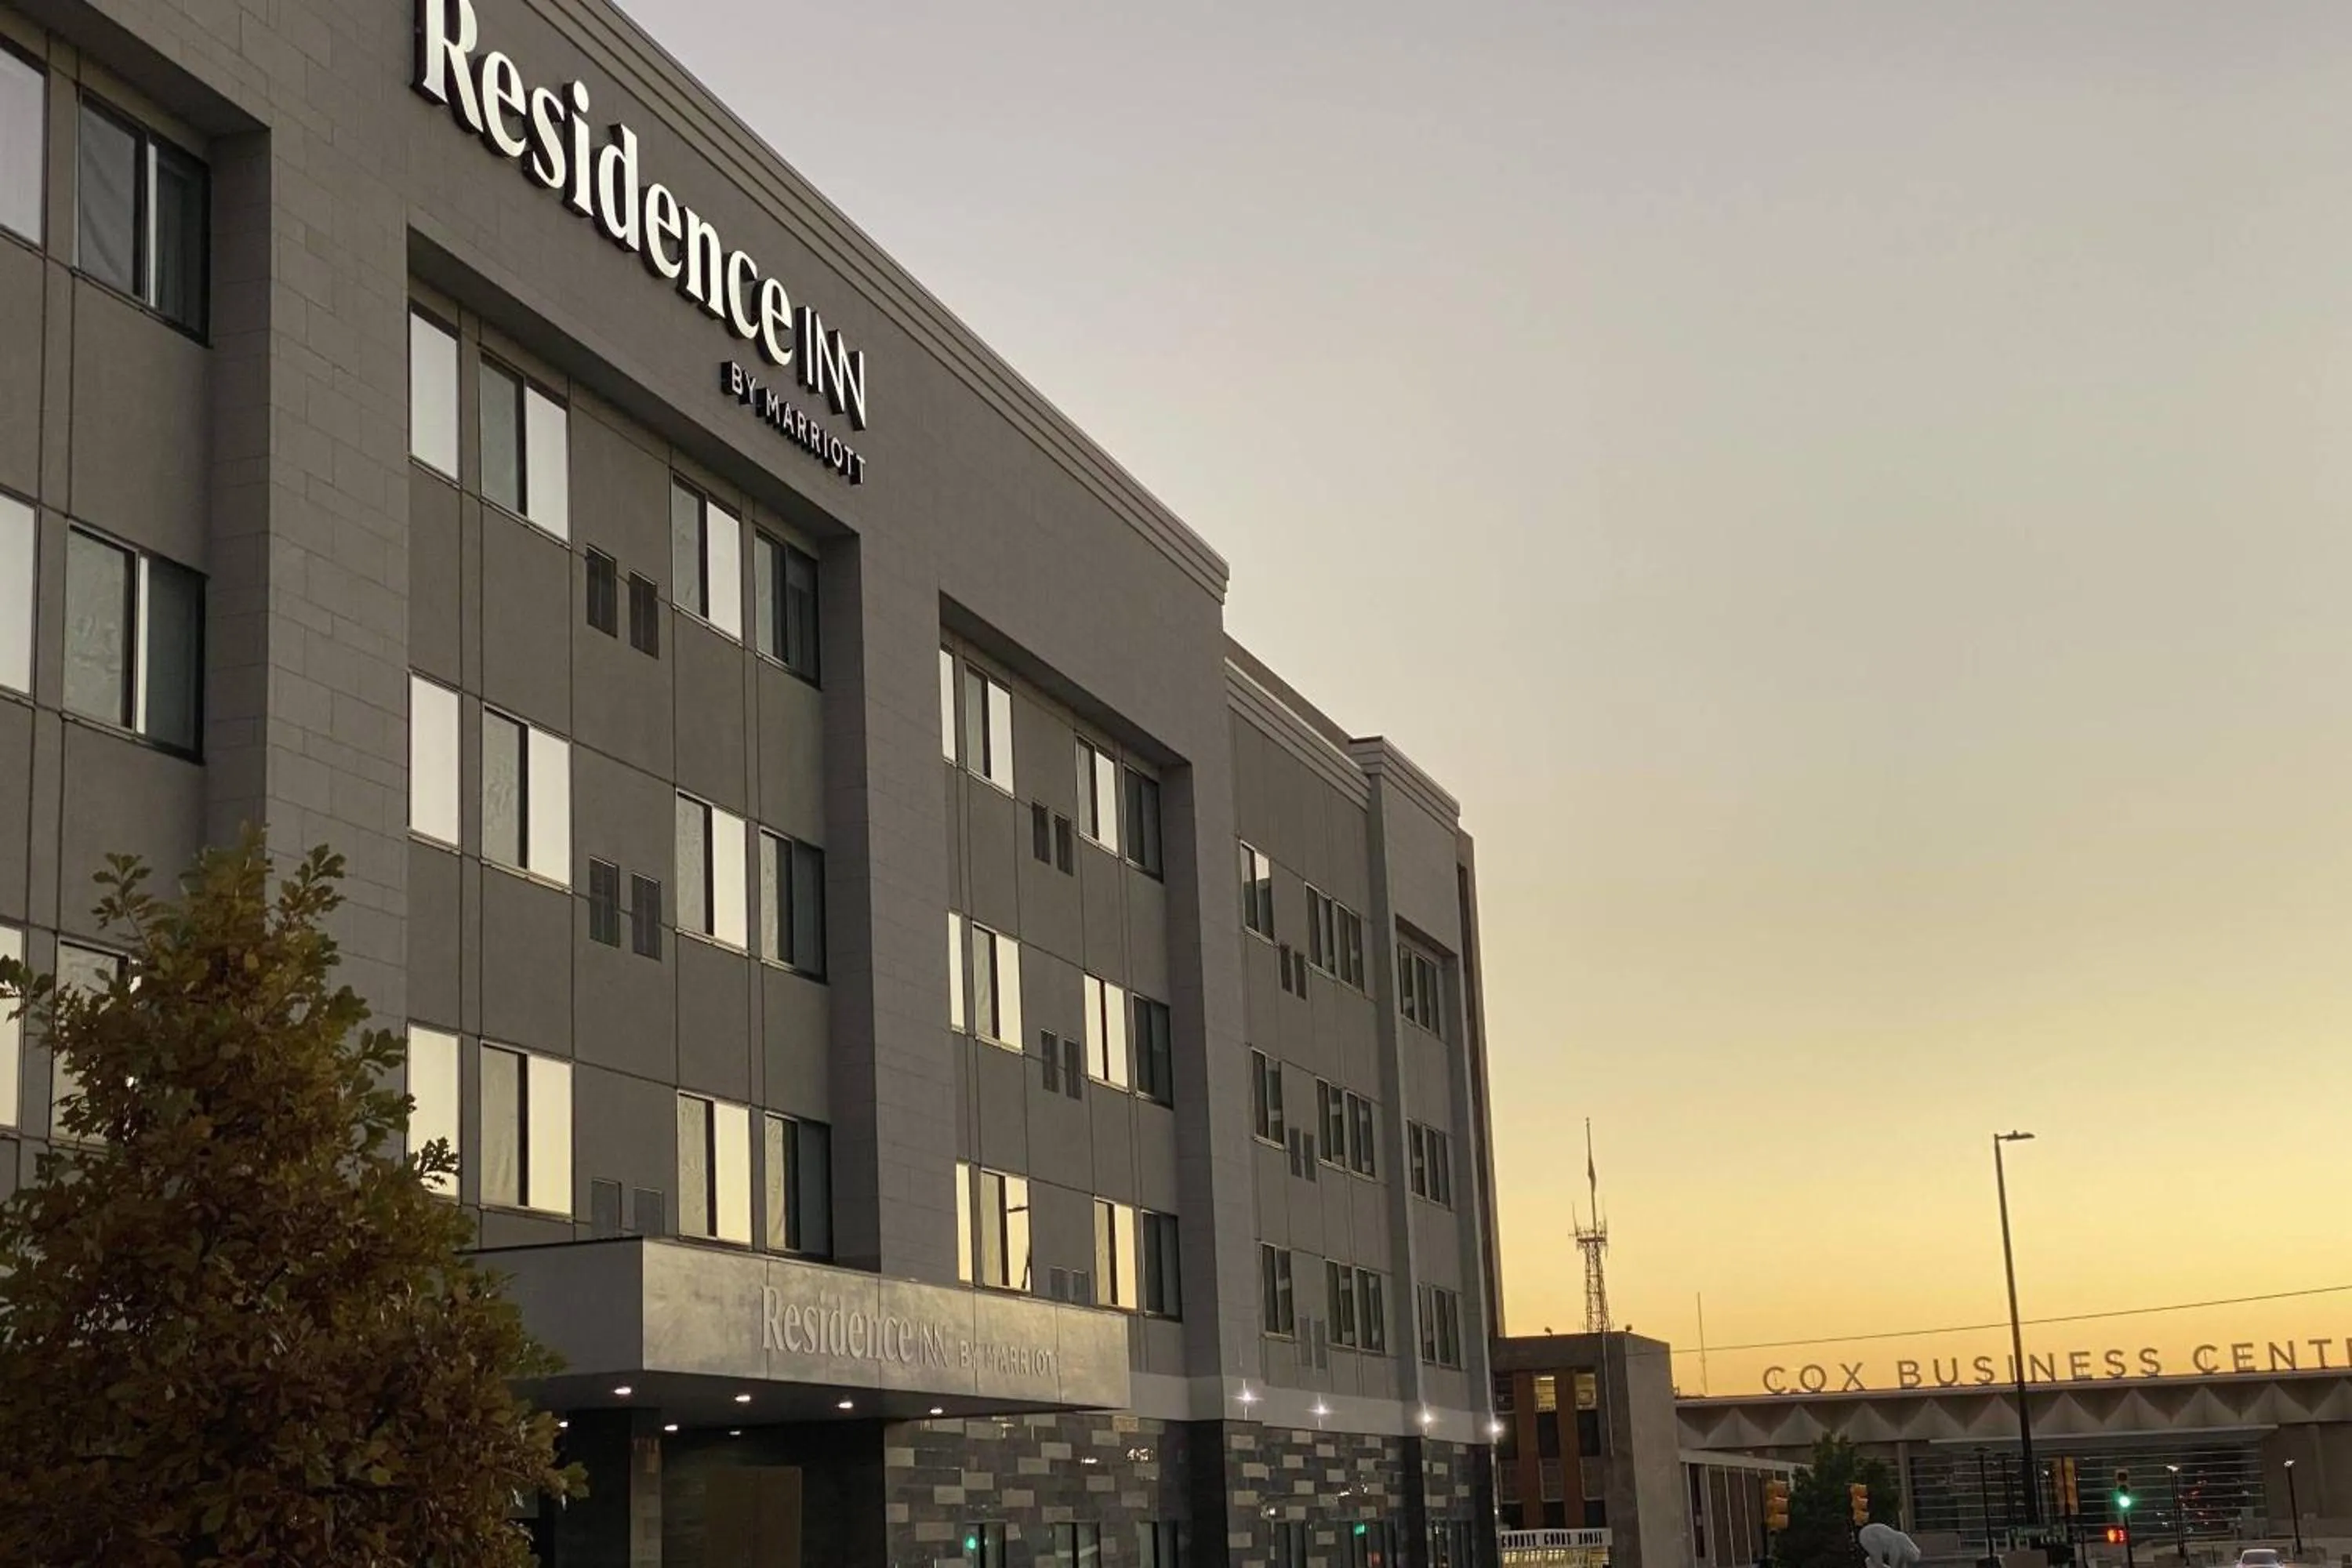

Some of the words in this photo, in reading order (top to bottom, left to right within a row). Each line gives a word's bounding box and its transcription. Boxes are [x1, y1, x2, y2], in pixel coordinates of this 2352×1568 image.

[421, 0, 793, 366] Residence
[803, 306, 866, 430] INN
[728, 361, 756, 405] BY
[765, 388, 866, 485] MARRIOTT
[762, 1286, 913, 1363] Residence
[918, 1320, 948, 1367] INN
[960, 1340, 978, 1369] BY
[1762, 1363, 1867, 1394] COX
[1896, 1347, 2162, 1389] BUSINESS
